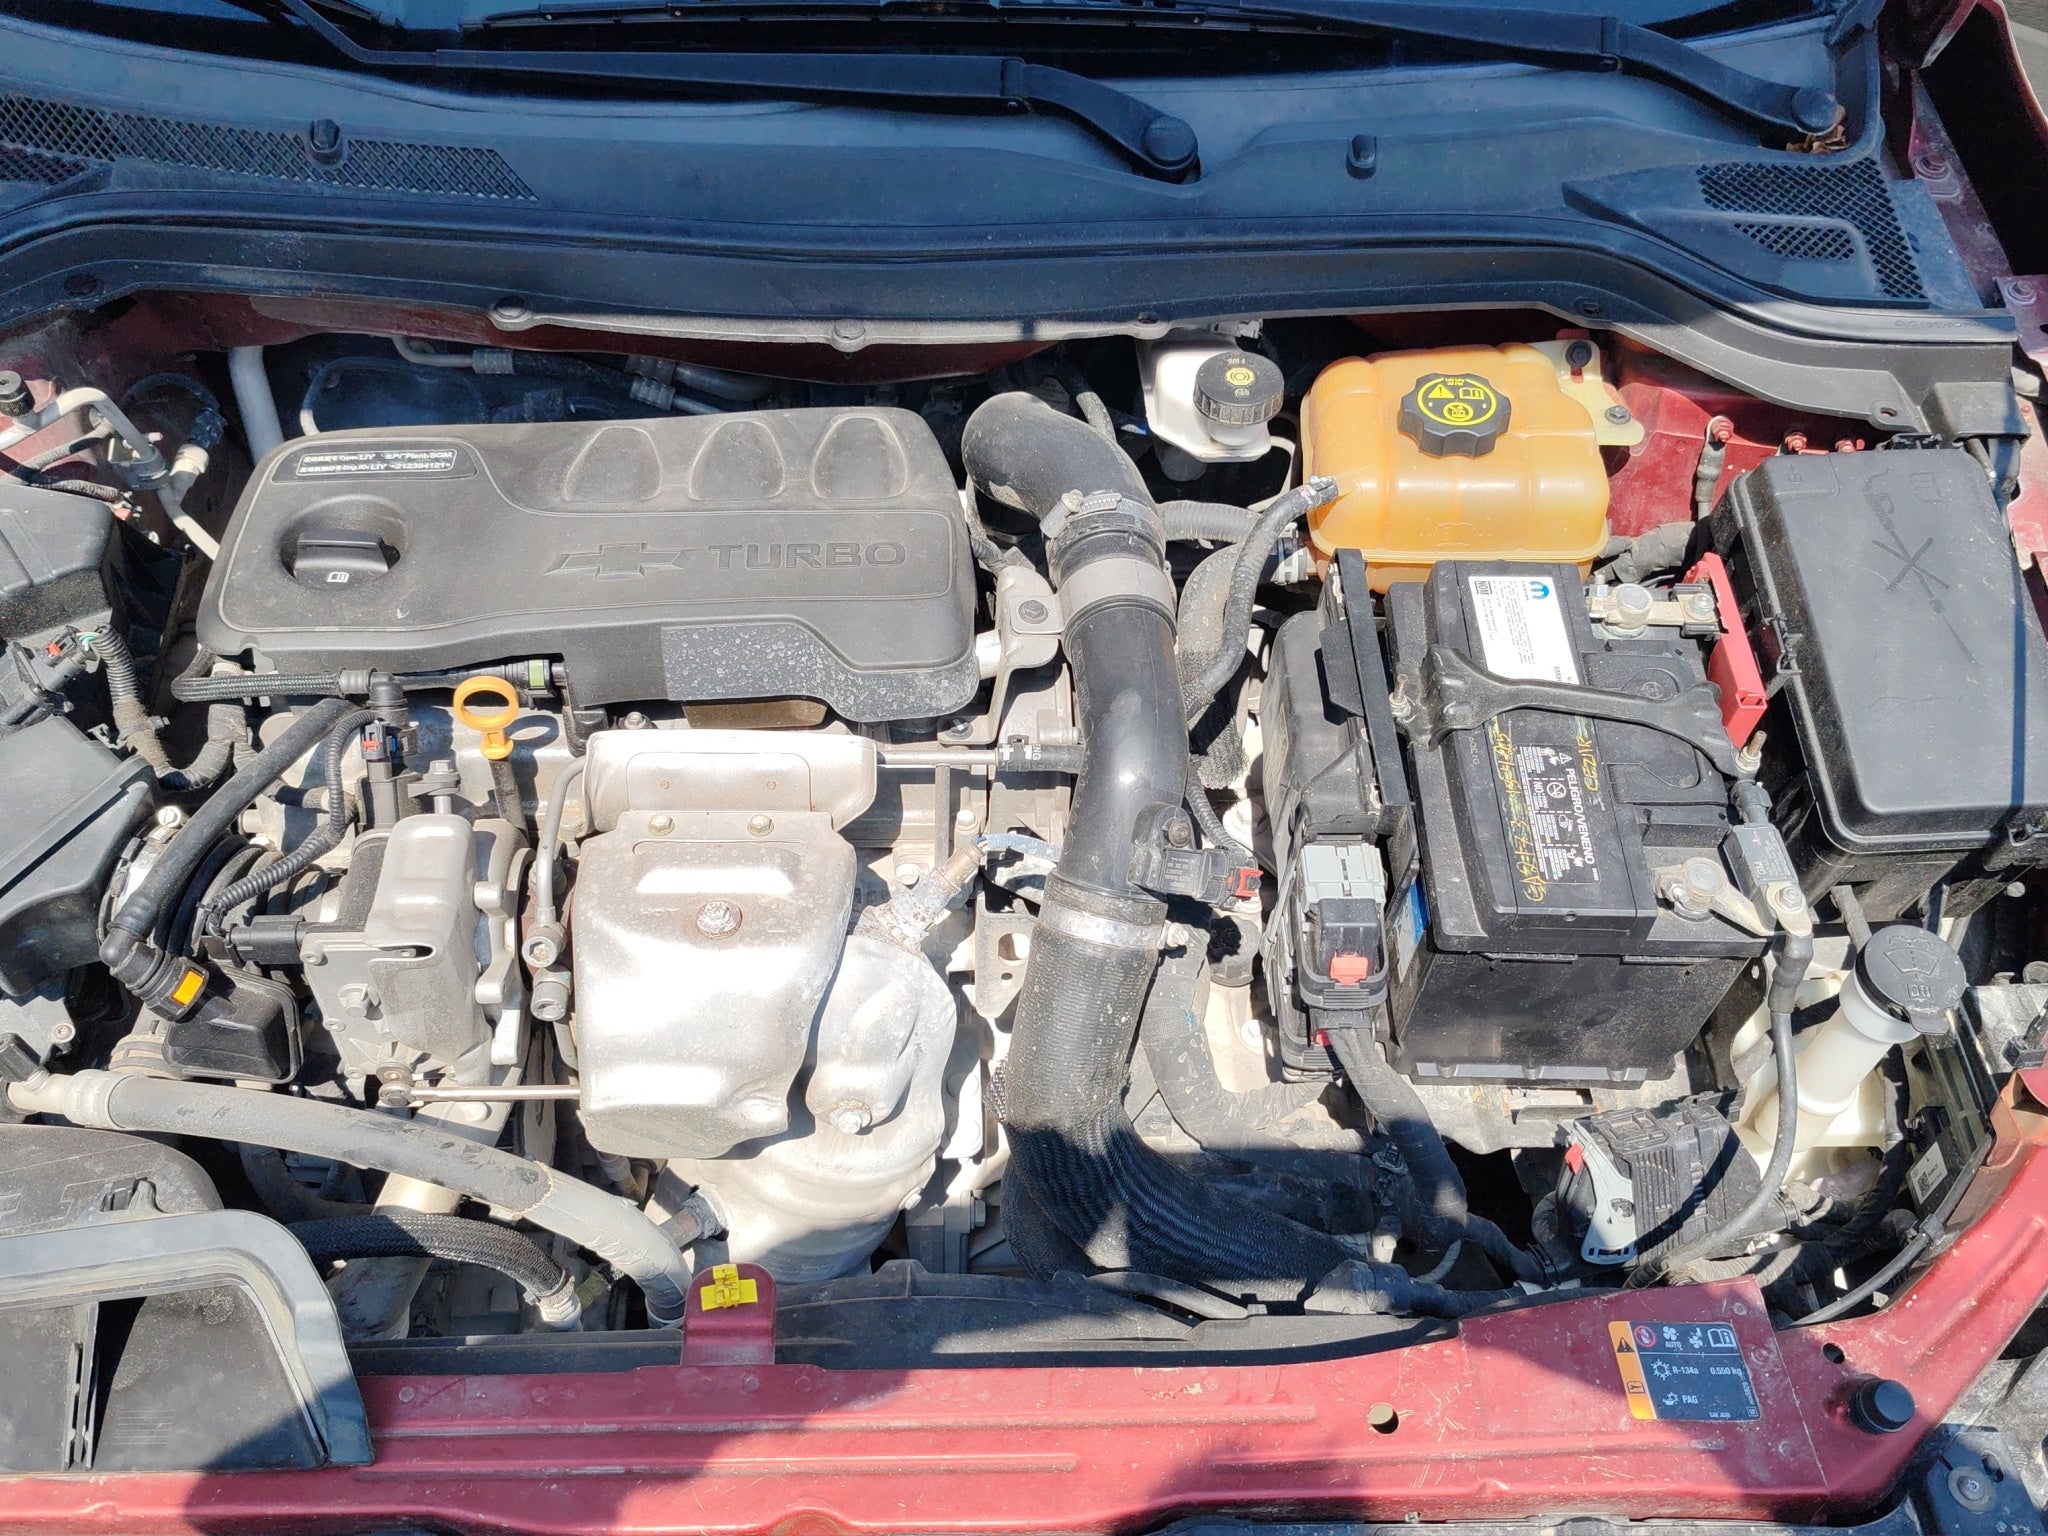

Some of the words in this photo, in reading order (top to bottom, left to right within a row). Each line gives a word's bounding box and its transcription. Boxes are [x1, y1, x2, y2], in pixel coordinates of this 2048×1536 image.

[707, 541, 907, 571] TURBO
[1565, 768, 1595, 865] PELIGRO/VENENO
[1672, 1366, 1699, 1375] R-134a
[1709, 1366, 1730, 1375] 0.550
[1732, 1367, 1743, 1377] kg
[1682, 1395, 1699, 1404] PAG
